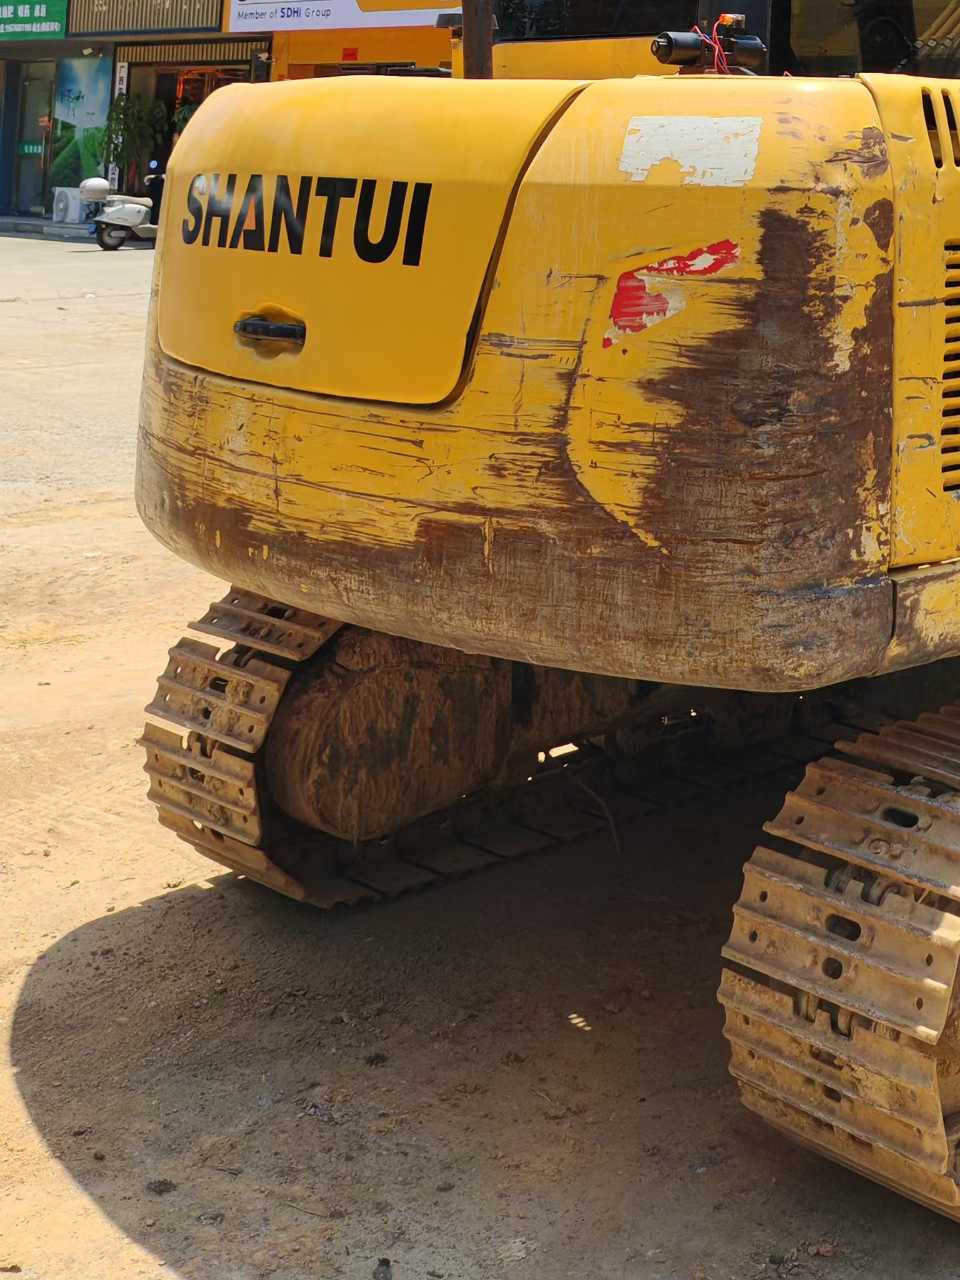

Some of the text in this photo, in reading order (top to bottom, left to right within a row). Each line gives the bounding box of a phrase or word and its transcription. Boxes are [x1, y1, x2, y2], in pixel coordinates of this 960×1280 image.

[237, 9, 267, 20] Member
[269, 8, 278, 18] of
[304, 7, 332, 18] Group
[182, 173, 433, 267] SHANTUI
